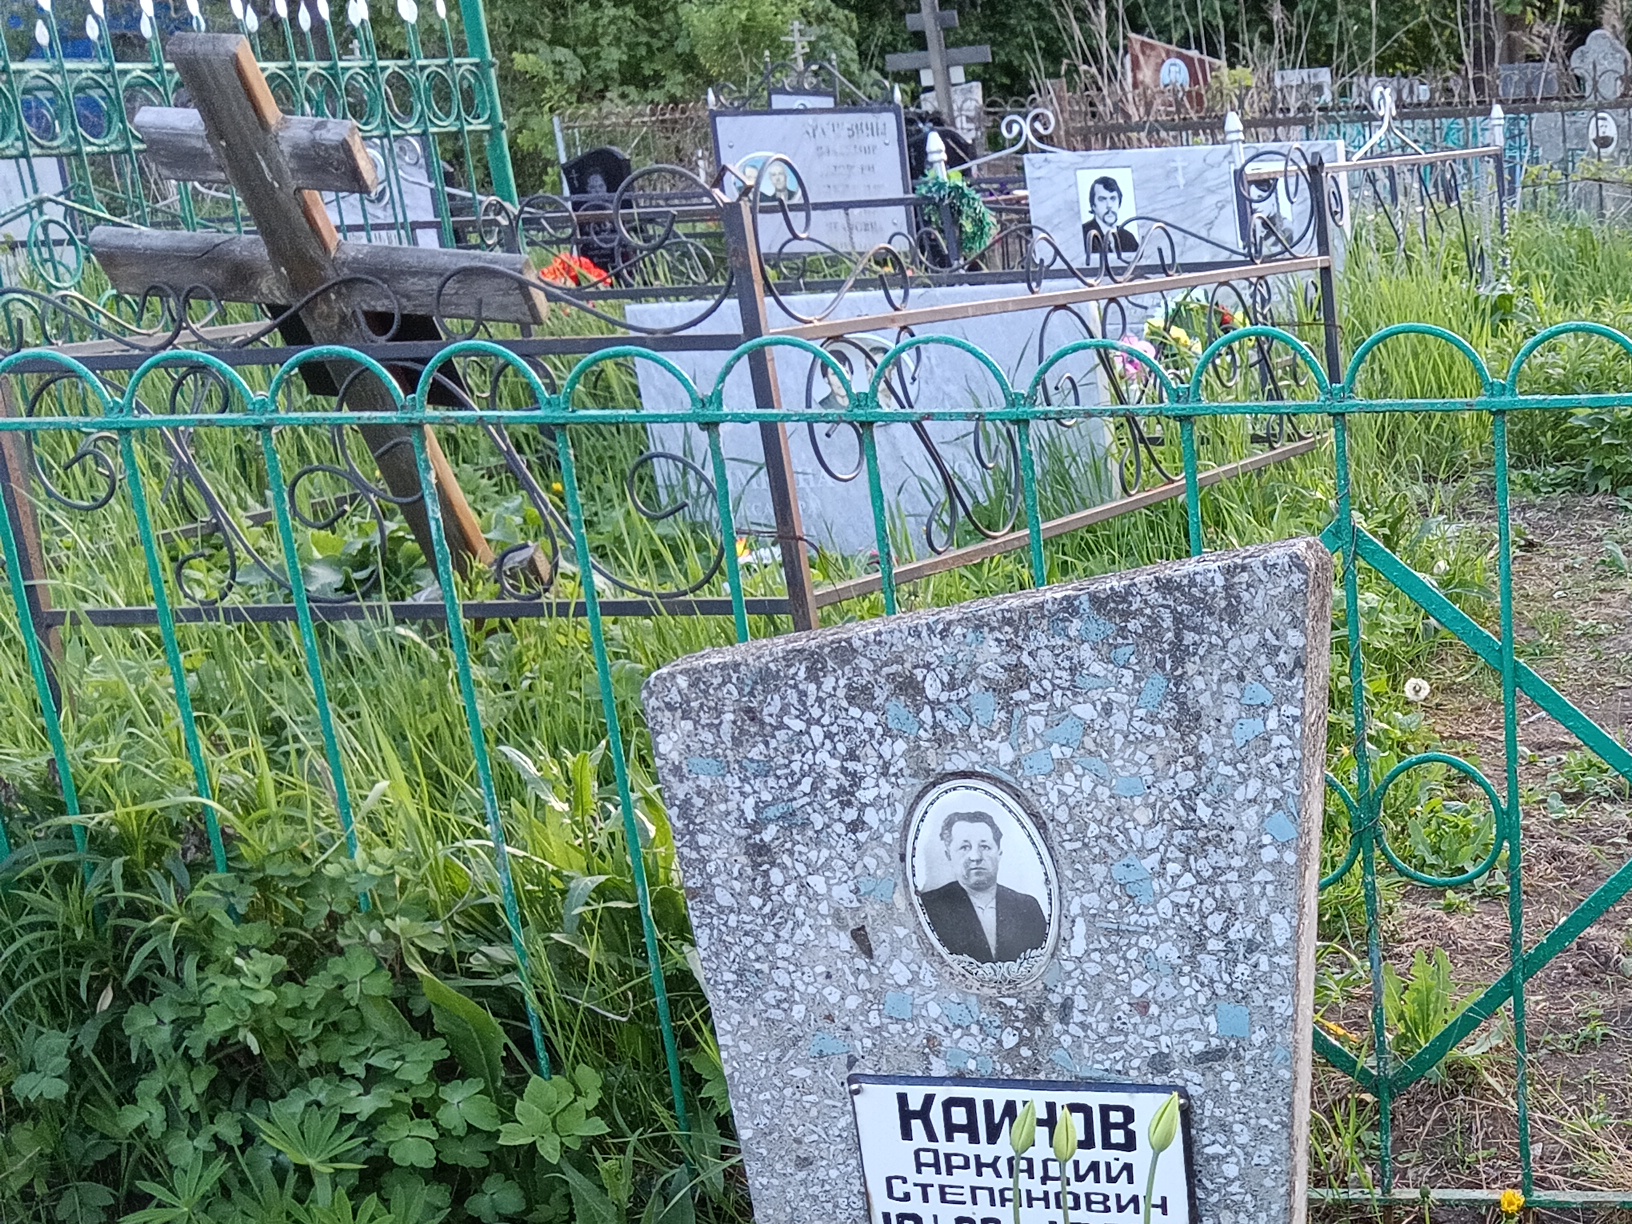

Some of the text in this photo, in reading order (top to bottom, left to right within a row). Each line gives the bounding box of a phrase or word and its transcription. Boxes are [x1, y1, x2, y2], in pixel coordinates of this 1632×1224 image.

[896, 1092, 1137, 1152] КАИНОВ
[914, 1147, 1134, 1186] АРКАДИЙ
[885, 1175, 1168, 1216] СТЕПАНОВИЧ
